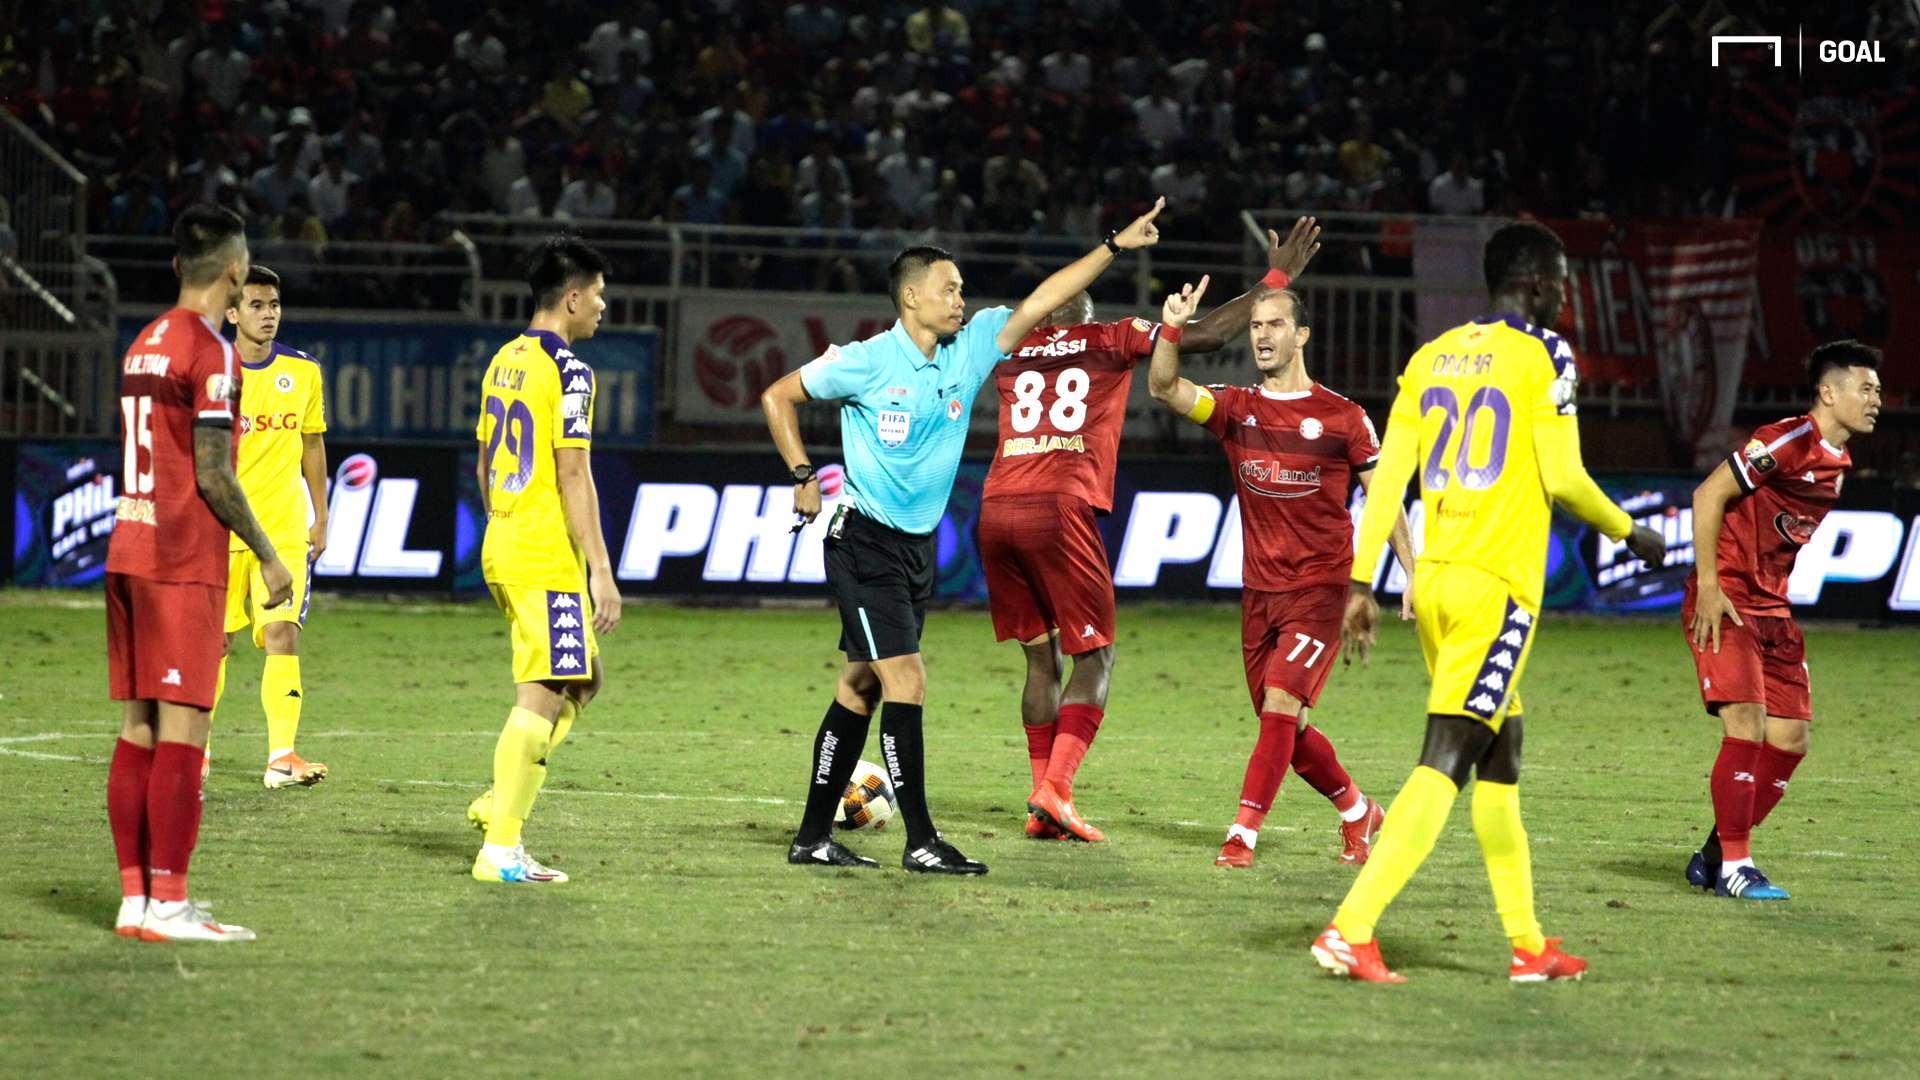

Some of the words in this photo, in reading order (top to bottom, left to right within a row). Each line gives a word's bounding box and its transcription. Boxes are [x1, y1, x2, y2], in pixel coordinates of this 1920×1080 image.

[1018, 338, 1088, 358] EPASSI
[255, 412, 297, 432] SCG
[881, 413, 906, 424] FIFA
[1010, 367, 1091, 434] 88
[121, 395, 156, 494] 15
[485, 394, 535, 495] 29
[1003, 435, 1085, 458] BERJAYA
[1419, 385, 1512, 491] 20
[1286, 632, 1325, 669] 77
[816, 730, 839, 785] JOGARBOLA
[883, 732, 904, 789] JOGARBOLA
